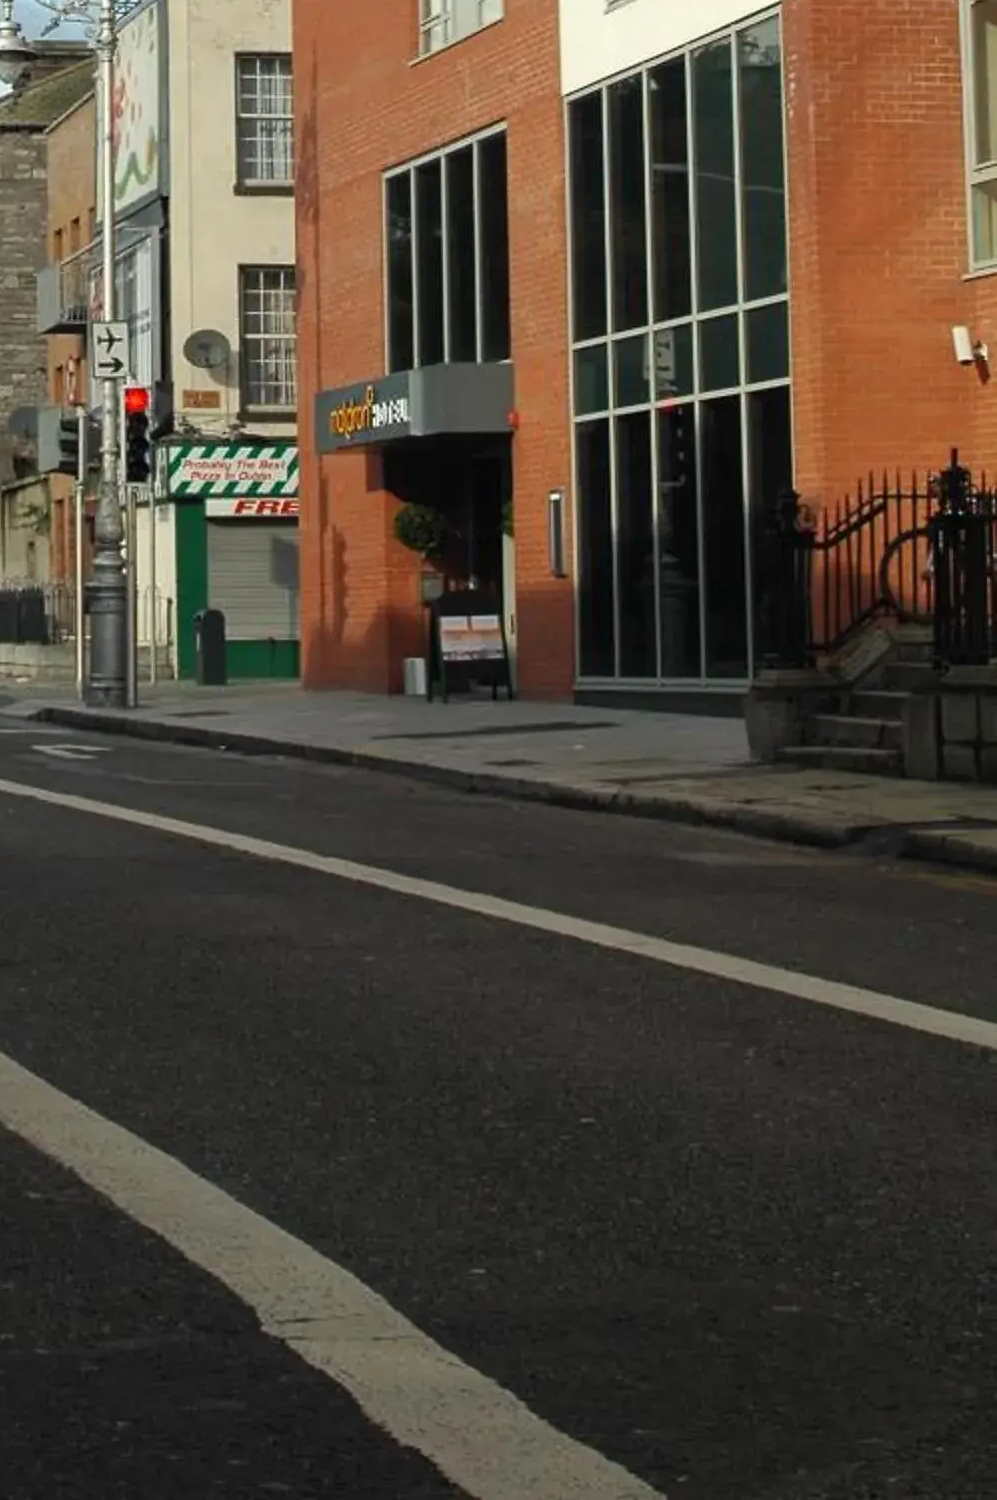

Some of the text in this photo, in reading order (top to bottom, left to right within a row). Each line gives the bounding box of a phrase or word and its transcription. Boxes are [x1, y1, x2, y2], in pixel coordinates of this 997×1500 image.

[237, 460, 254, 469] The
[258, 459, 286, 469] Best
[191, 471, 220, 480] Pizza
[238, 471, 272, 480] Dublin
